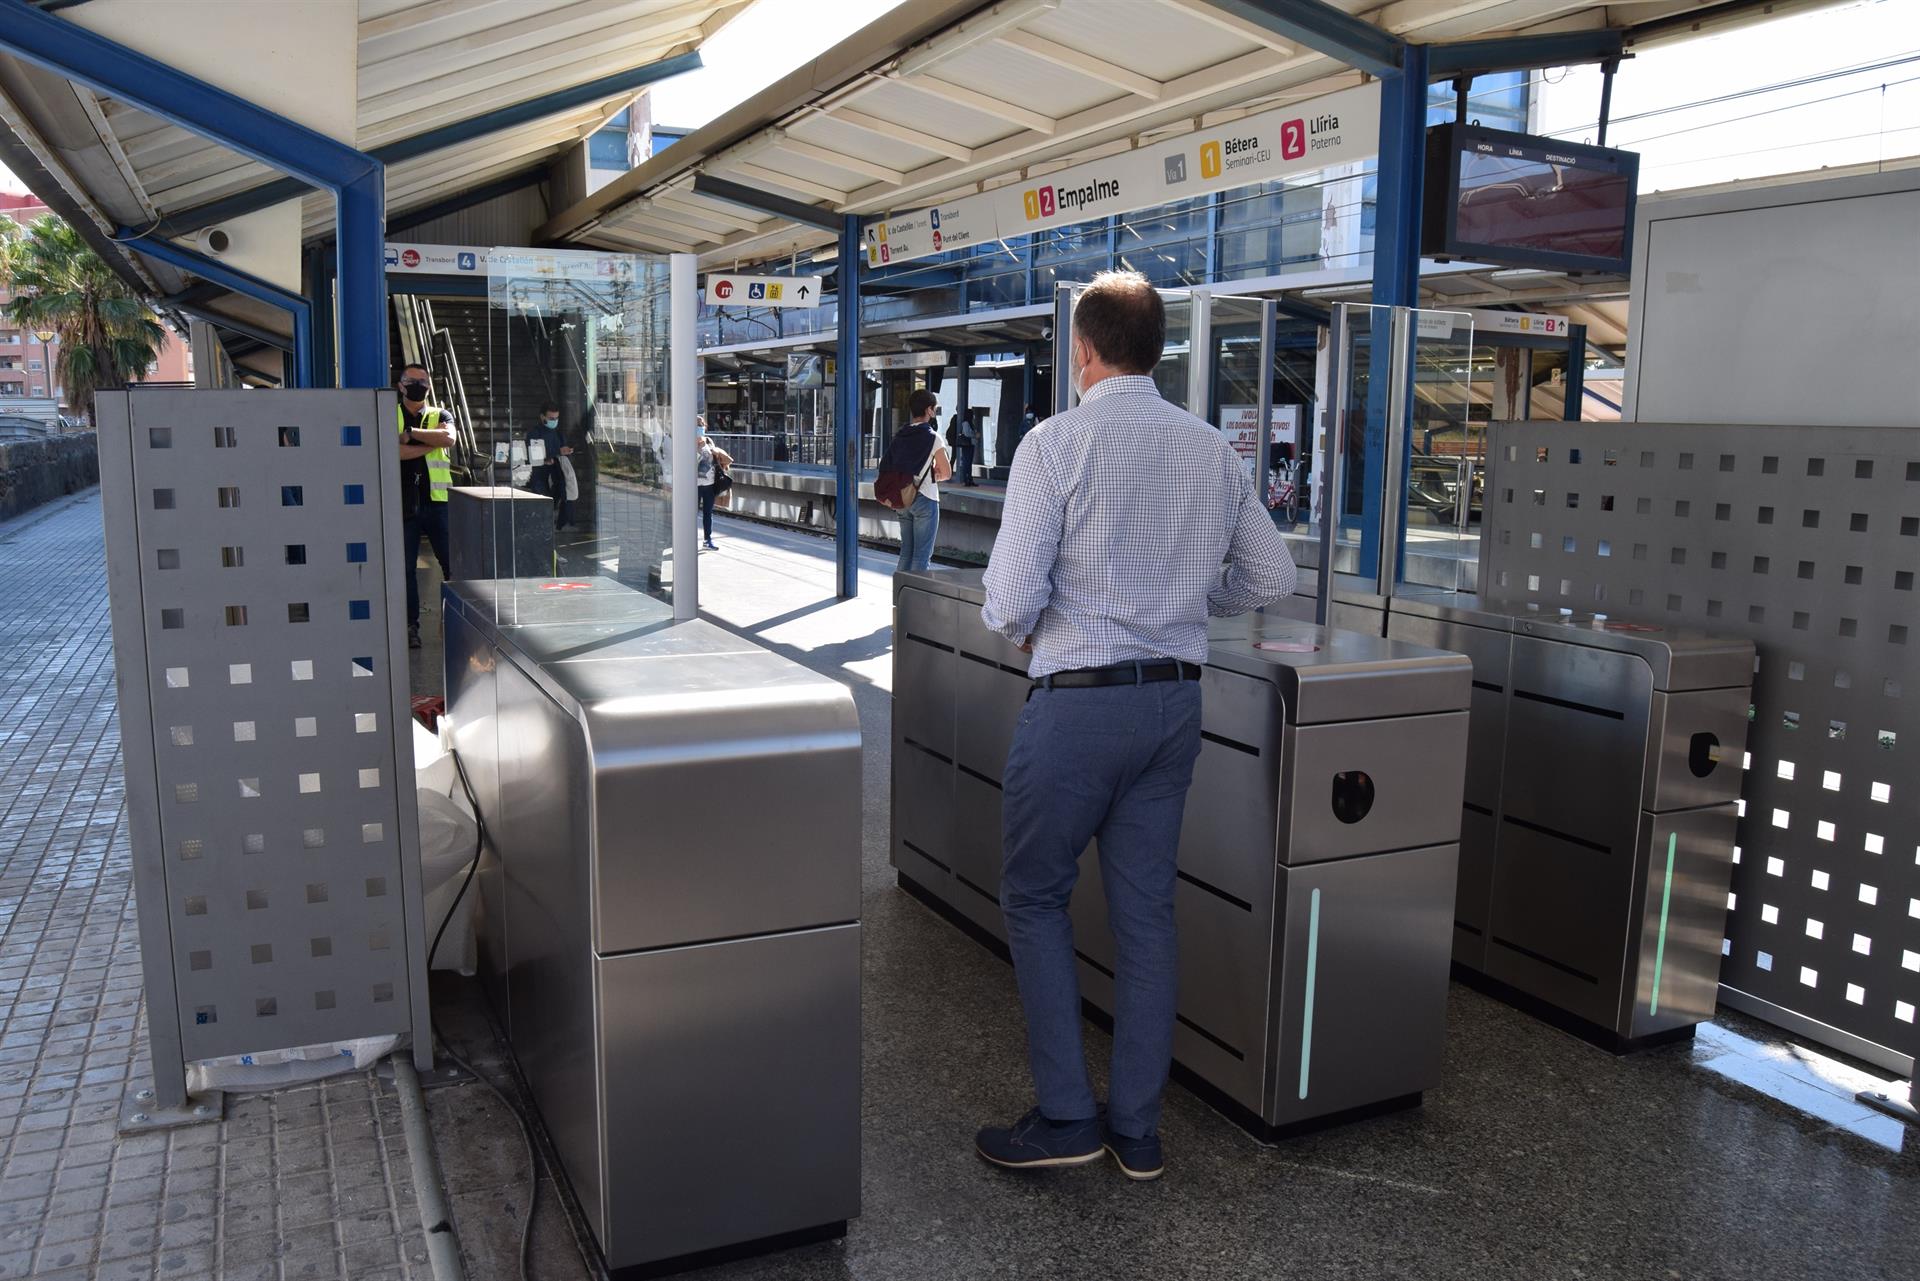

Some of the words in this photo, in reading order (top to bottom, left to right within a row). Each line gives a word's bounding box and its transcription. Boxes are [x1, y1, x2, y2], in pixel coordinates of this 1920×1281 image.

[1286, 126, 1299, 154] 2
[1309, 114, 1340, 135] Llíria
[1310, 134, 1342, 151] Paterna
[1224, 135, 1259, 155] Bétera
[1477, 143, 1494, 153] HORA
[1508, 146, 1523, 157] LÍNIA
[1545, 153, 1576, 165] DESTINACIÓ
[1178, 161, 1185, 178] 1
[1225, 149, 1271, 170] Seminari-CEU
[1057, 178, 1120, 211] Empalme
[425, 256, 456, 264] Transbord
[479, 255, 487, 263] V.
